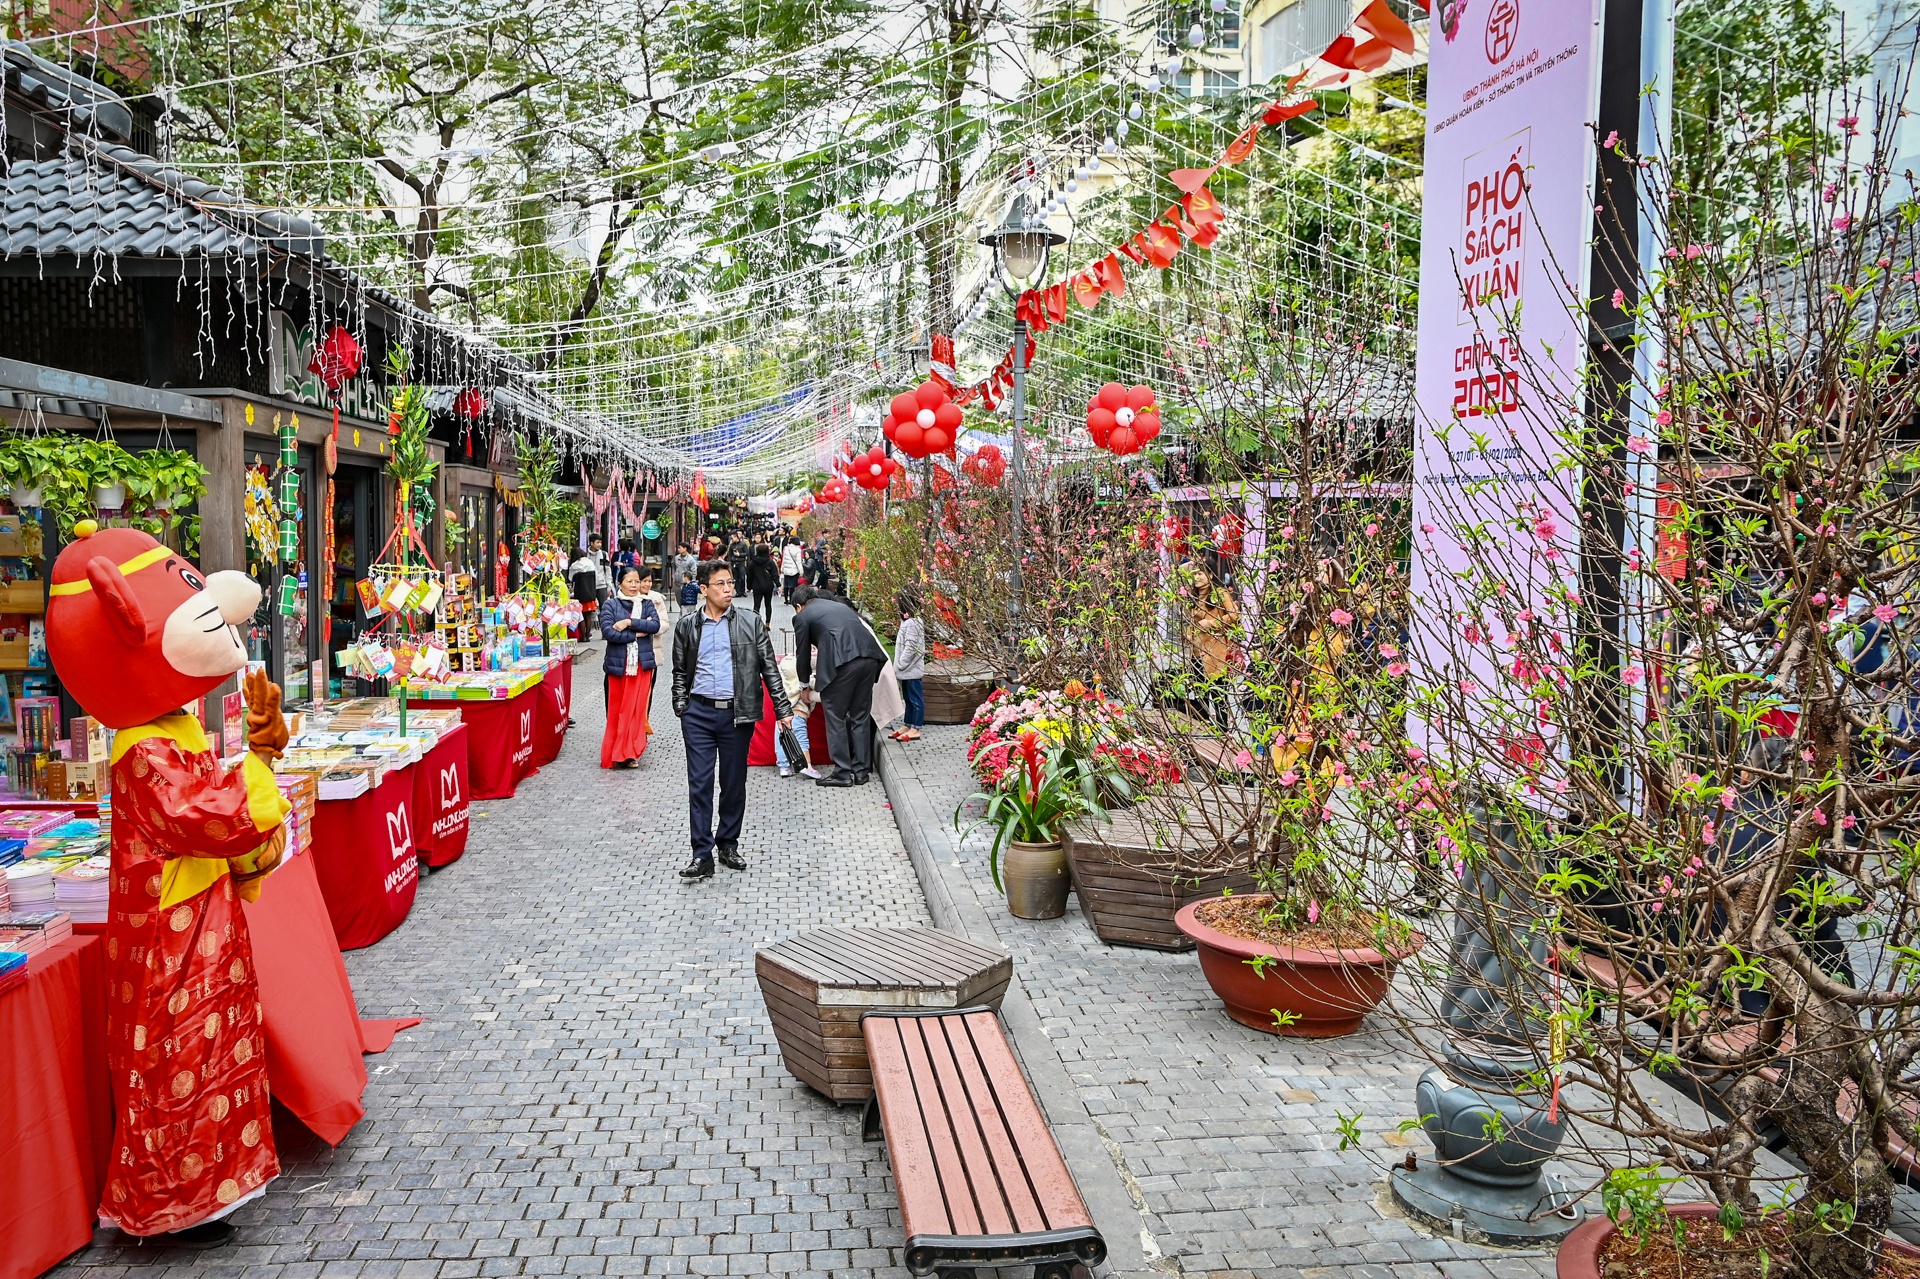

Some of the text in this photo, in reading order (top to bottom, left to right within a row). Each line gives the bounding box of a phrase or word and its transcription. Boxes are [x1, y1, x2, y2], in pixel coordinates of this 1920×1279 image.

[1463, 85, 1479, 102] UBND
[1501, 60, 1515, 80] PHỐ
[1527, 48, 1539, 65] NỘI
[1434, 121, 1445, 134] UBND
[1516, 75, 1525, 86] TIN
[1466, 146, 1523, 226] PHỐ
[1465, 211, 1522, 265] SÁCH
[1462, 257, 1519, 311] XUÂN
[1453, 370, 1519, 419] 2020
[1456, 450, 1474, 462] 27/01
